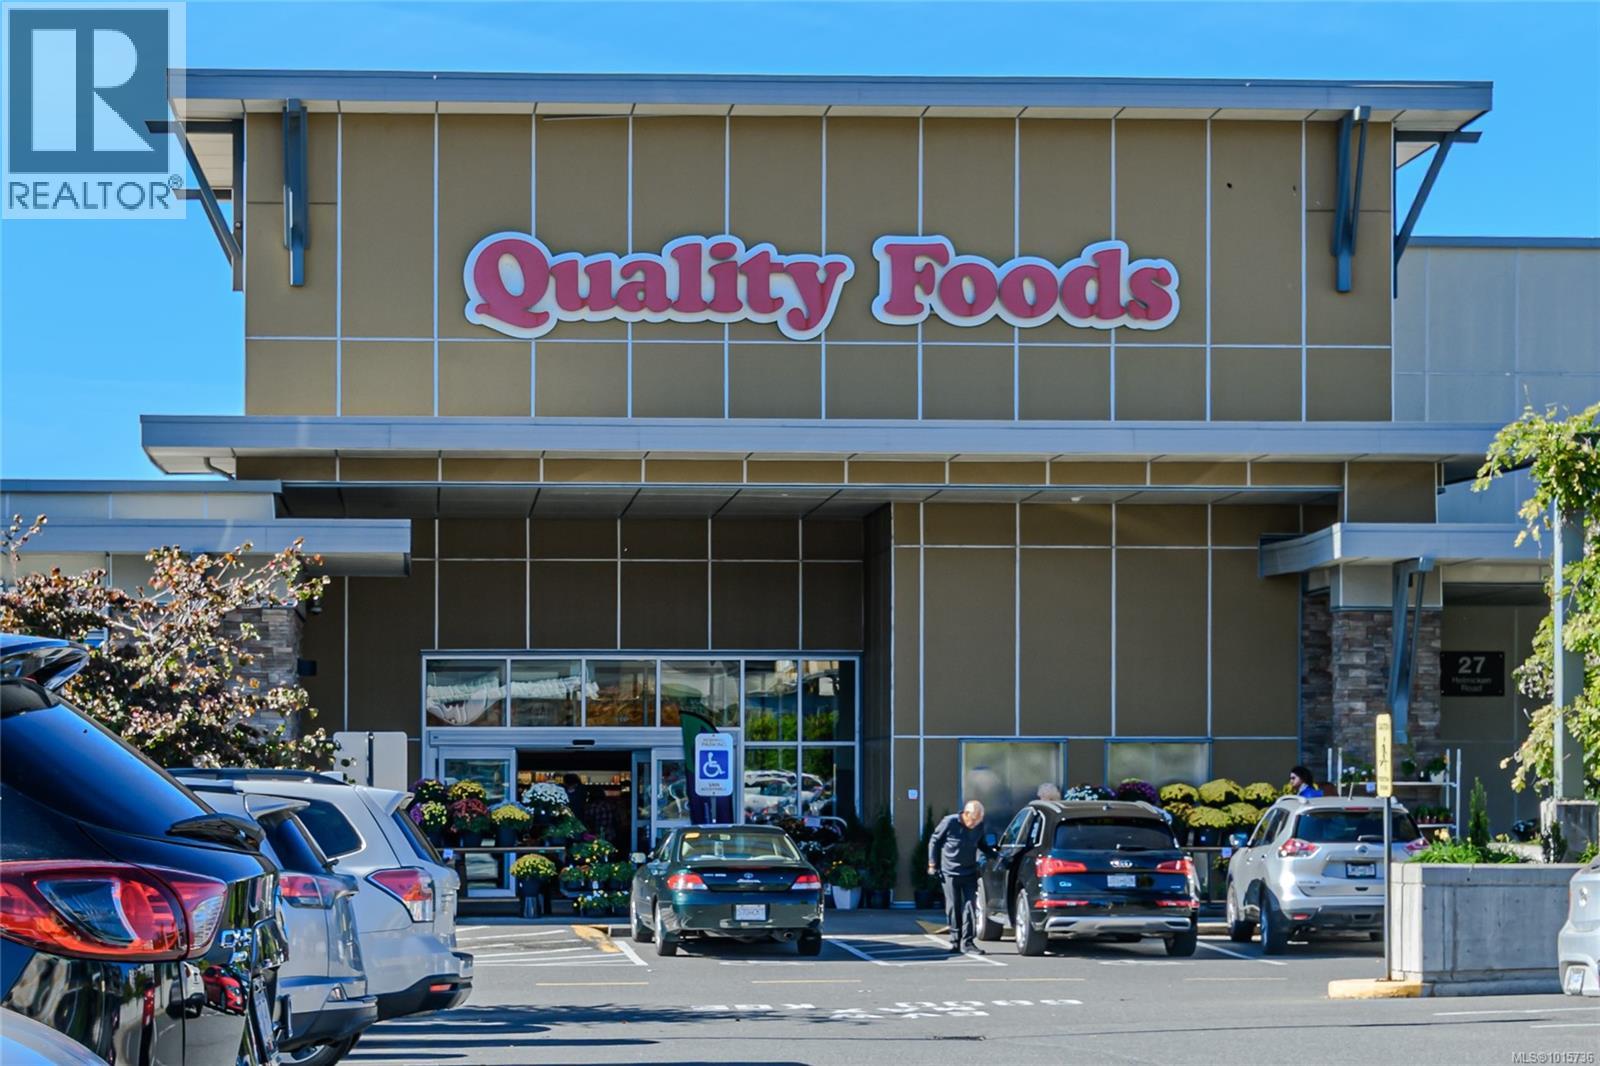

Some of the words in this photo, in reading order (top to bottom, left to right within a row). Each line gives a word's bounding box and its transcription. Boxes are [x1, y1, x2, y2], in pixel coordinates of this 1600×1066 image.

[472, 236, 848, 332] Quality
[882, 241, 1173, 321] Foods
[1458, 656, 1486, 673] 27
